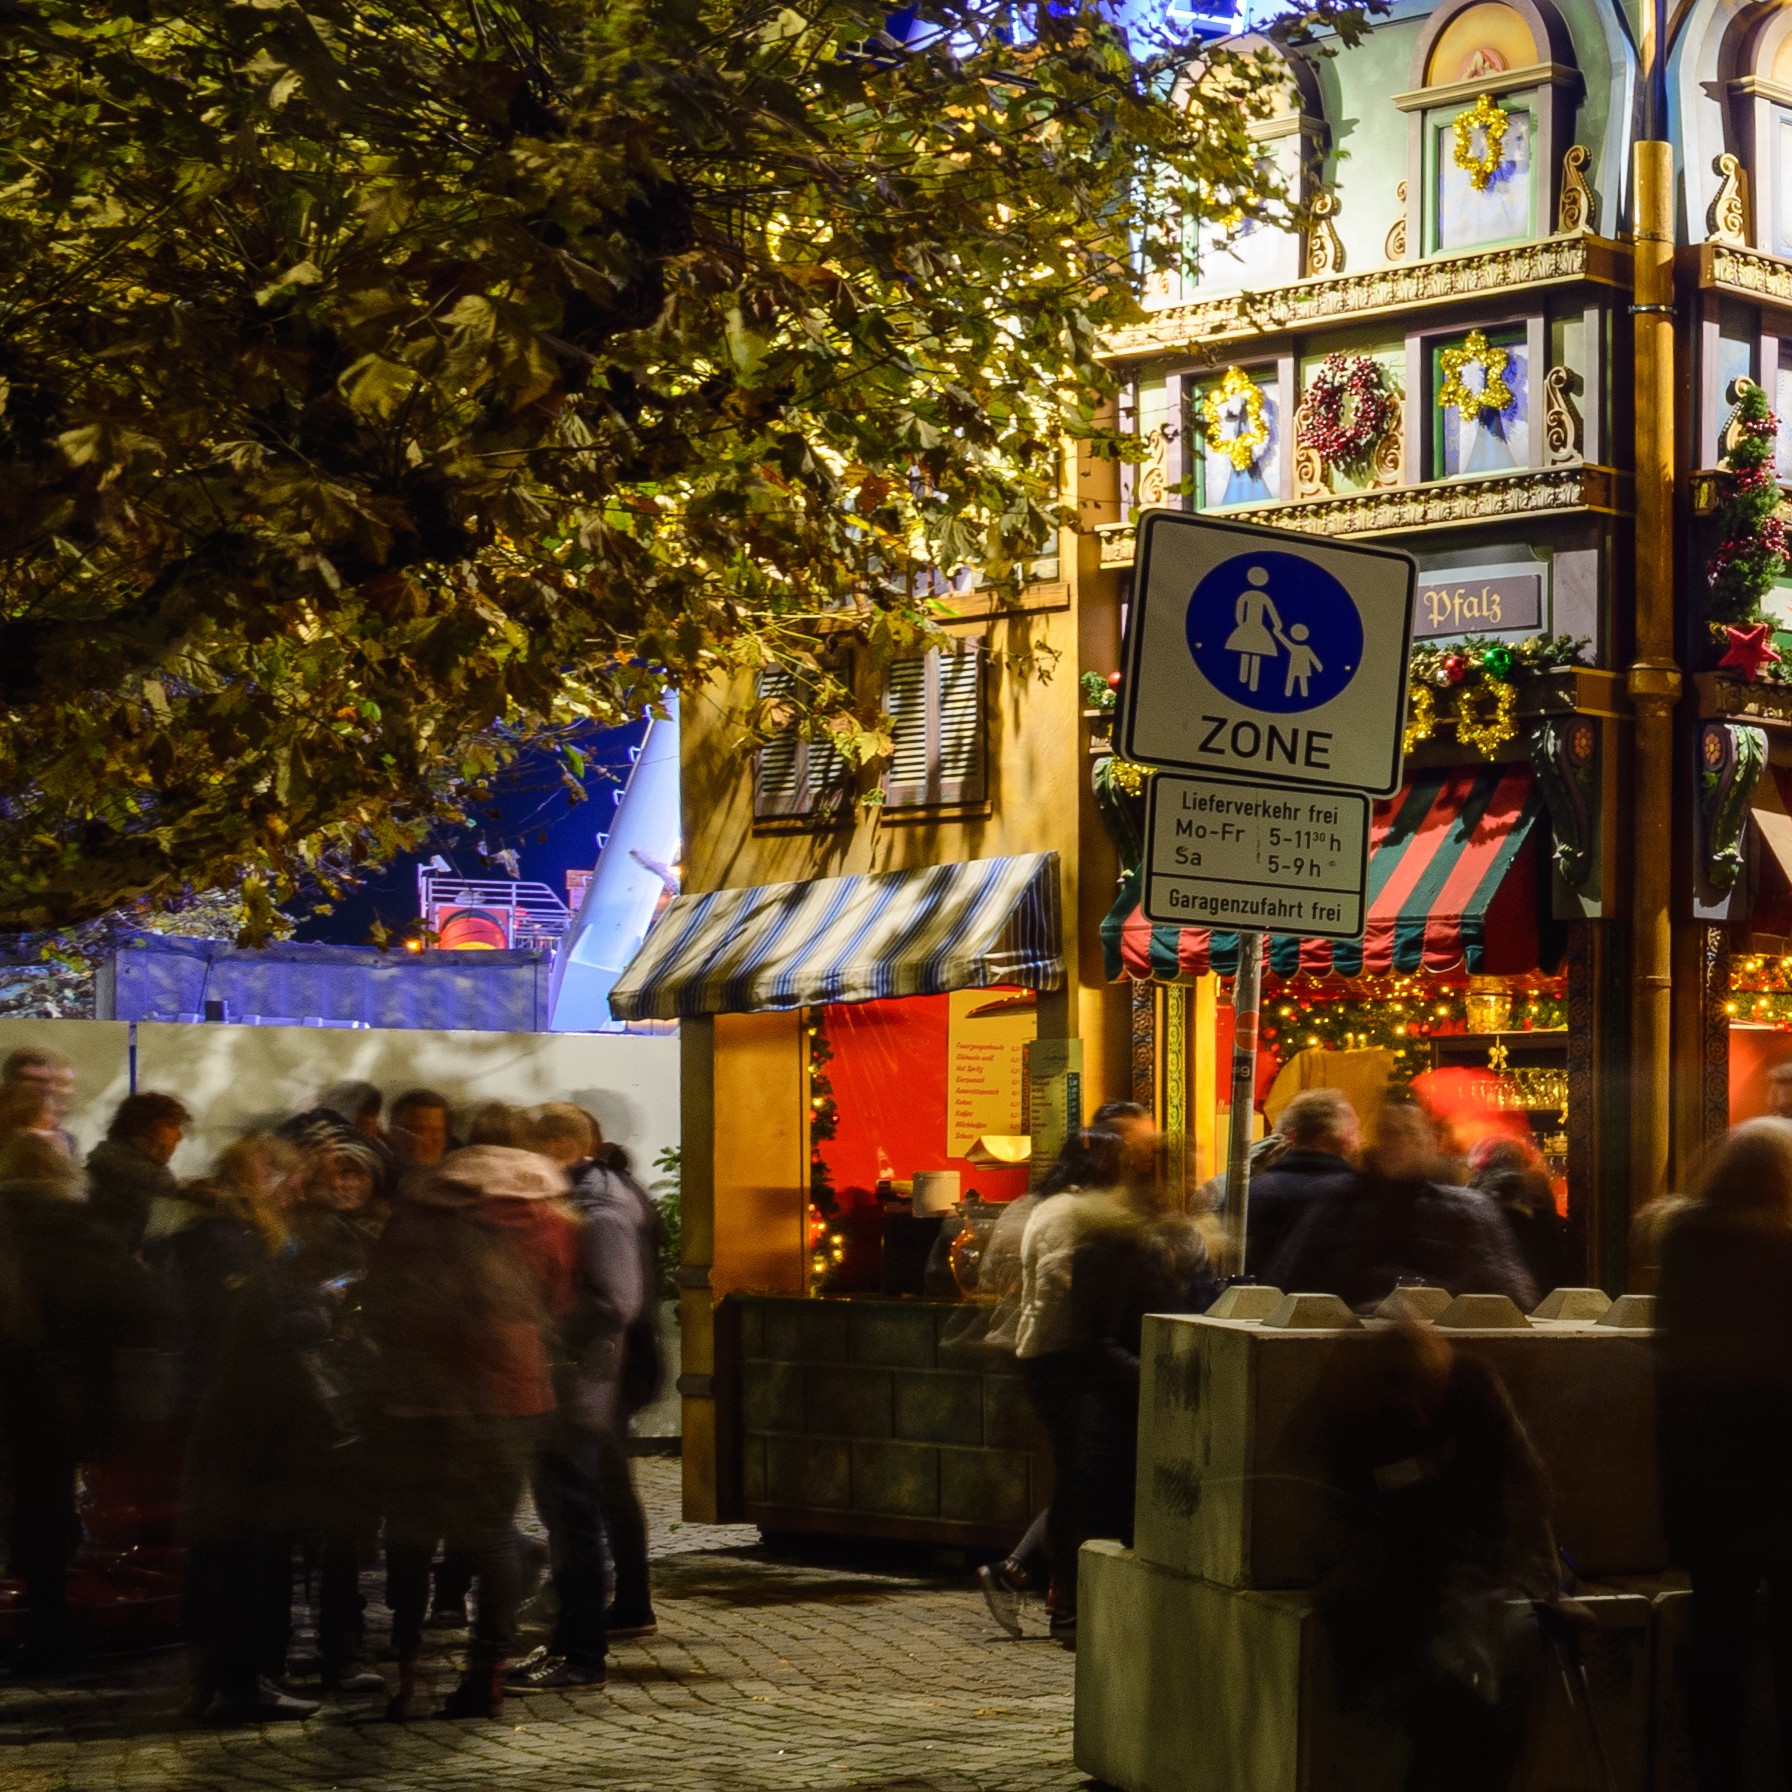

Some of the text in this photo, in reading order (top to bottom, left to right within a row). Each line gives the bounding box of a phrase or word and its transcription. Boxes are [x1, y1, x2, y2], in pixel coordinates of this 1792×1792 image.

[1424, 586, 1502, 629] Pfalz
[1198, 715, 1333, 770] ZONE
[1182, 791, 1338, 825] Lieferverkehr frei
[1175, 818, 1246, 842] Mo-Fr
[1329, 833, 1342, 852] h
[1175, 845, 1321, 877] Sa 5-9 h
[1169, 888, 1341, 922] Garagenzufahrt frei
